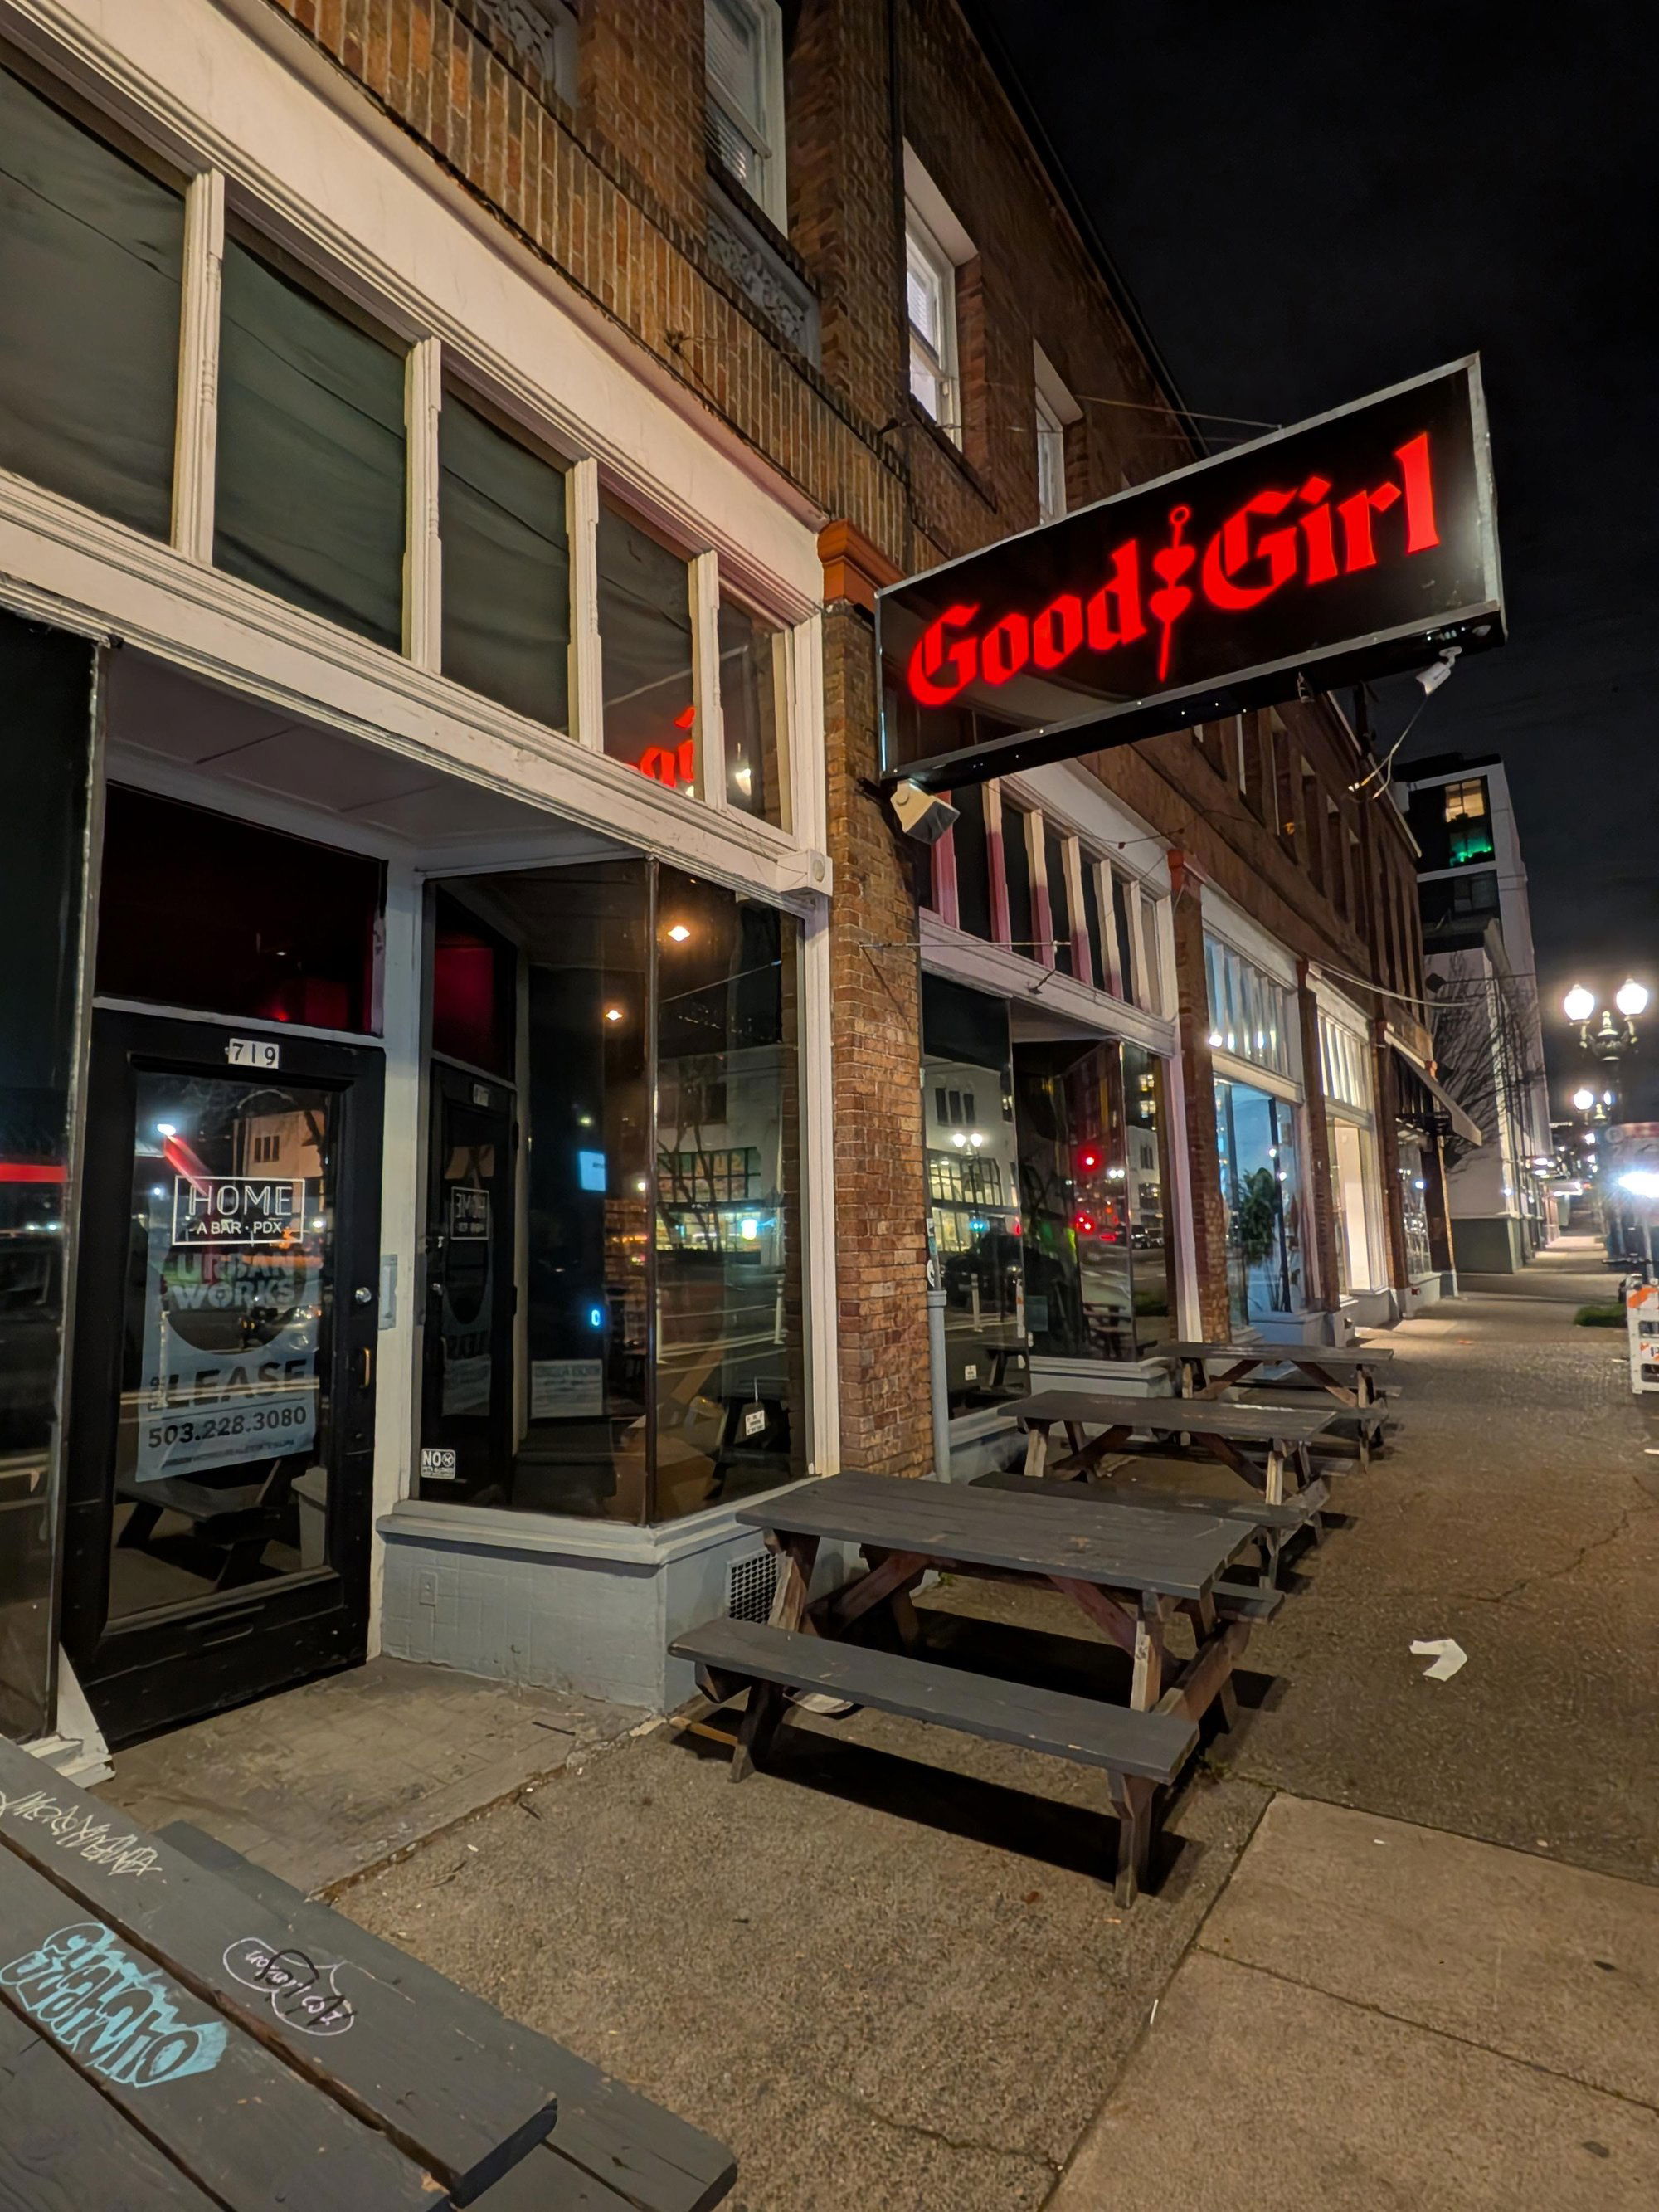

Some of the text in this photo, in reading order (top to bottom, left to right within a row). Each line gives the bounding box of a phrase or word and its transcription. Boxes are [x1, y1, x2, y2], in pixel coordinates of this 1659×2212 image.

[907, 431, 1440, 706] Good Girl
[232, 1042, 276, 1066] 719
[188, 1185, 293, 1216] HOME
[211, 1221, 241, 1235] BAR
[253, 1221, 282, 1234] PDX
[172, 1280, 295, 1309] WORKS
[166, 1359, 308, 1408] LEASE
[148, 1406, 307, 1448] 503.228.3080
